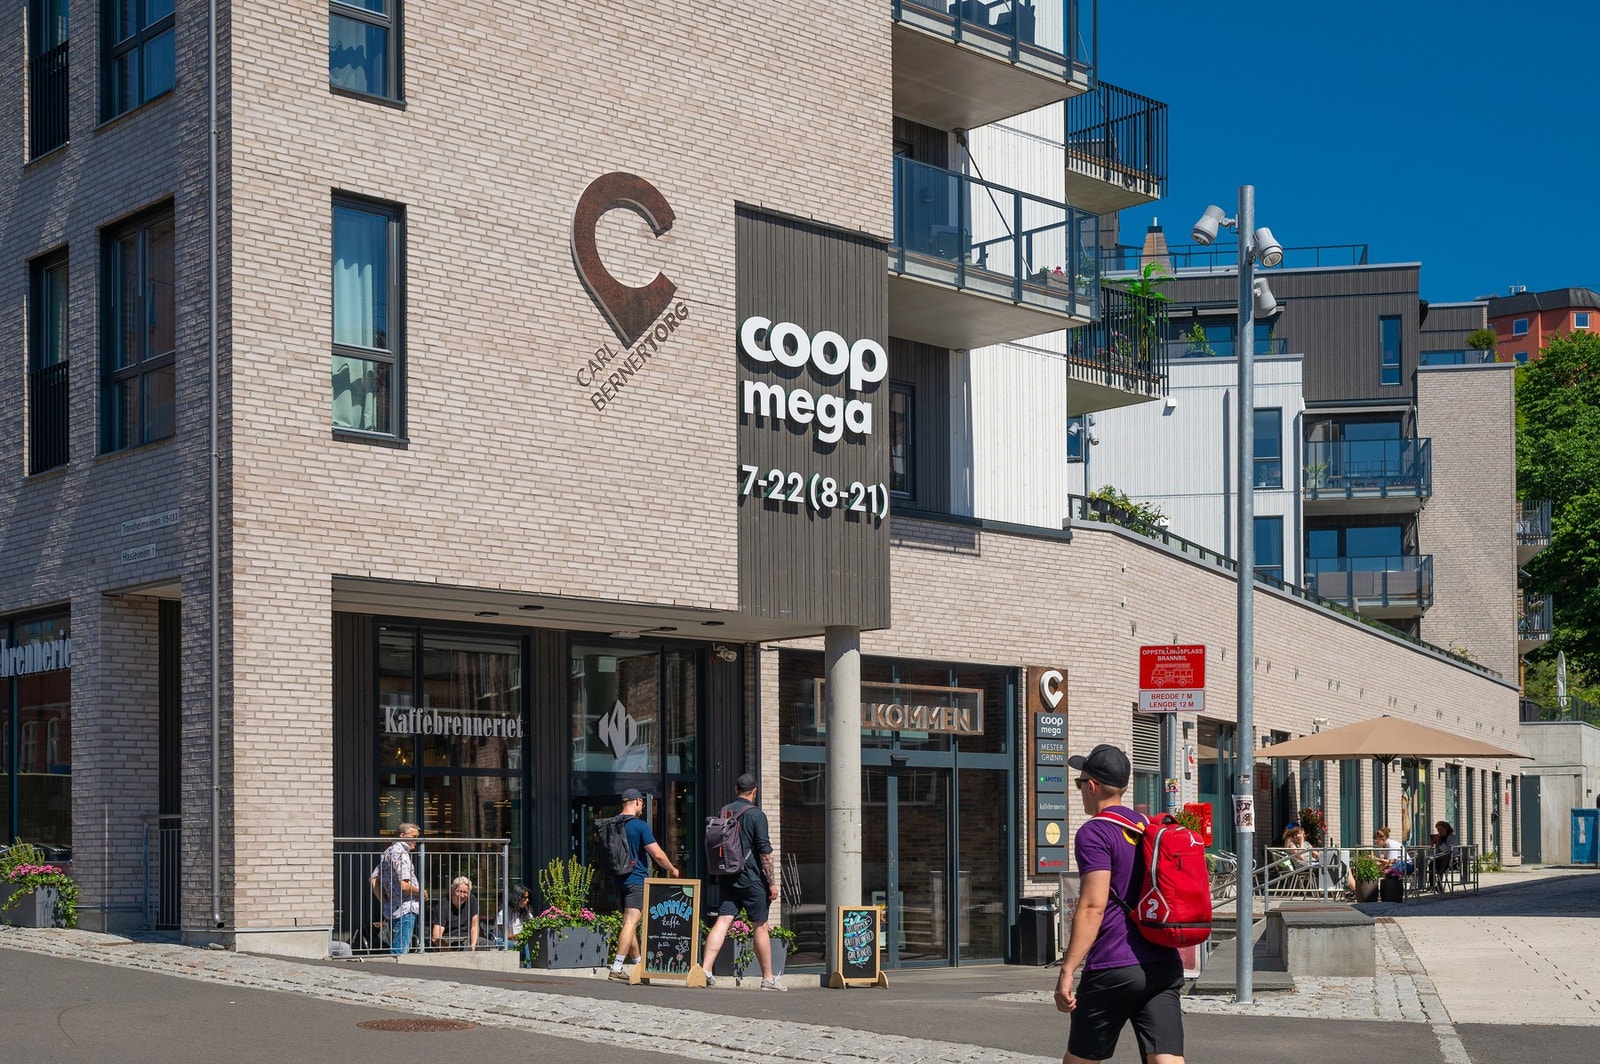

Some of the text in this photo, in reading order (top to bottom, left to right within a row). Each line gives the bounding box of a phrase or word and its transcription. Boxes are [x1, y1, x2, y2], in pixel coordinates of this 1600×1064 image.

[576, 343, 619, 387] CARL
[740, 315, 889, 392] coop
[743, 380, 872, 444] mega
[741, 464, 889, 520] 7-22 (8-21)
[0, 628, 72, 678] brennerie
[384, 706, 524, 738] Kaffebrenneriet
[861, 703, 970, 732] LKOMMEN
[1041, 716, 1064, 727] coop
[1041, 726, 1061, 736] mega
[1041, 743, 1064, 752] MESTER
[1041, 753, 1064, 761] GRØNN
[649, 899, 693, 922] SOMMER
[661, 915, 681, 929] kaffe
[1146, 898, 1159, 920] 2
